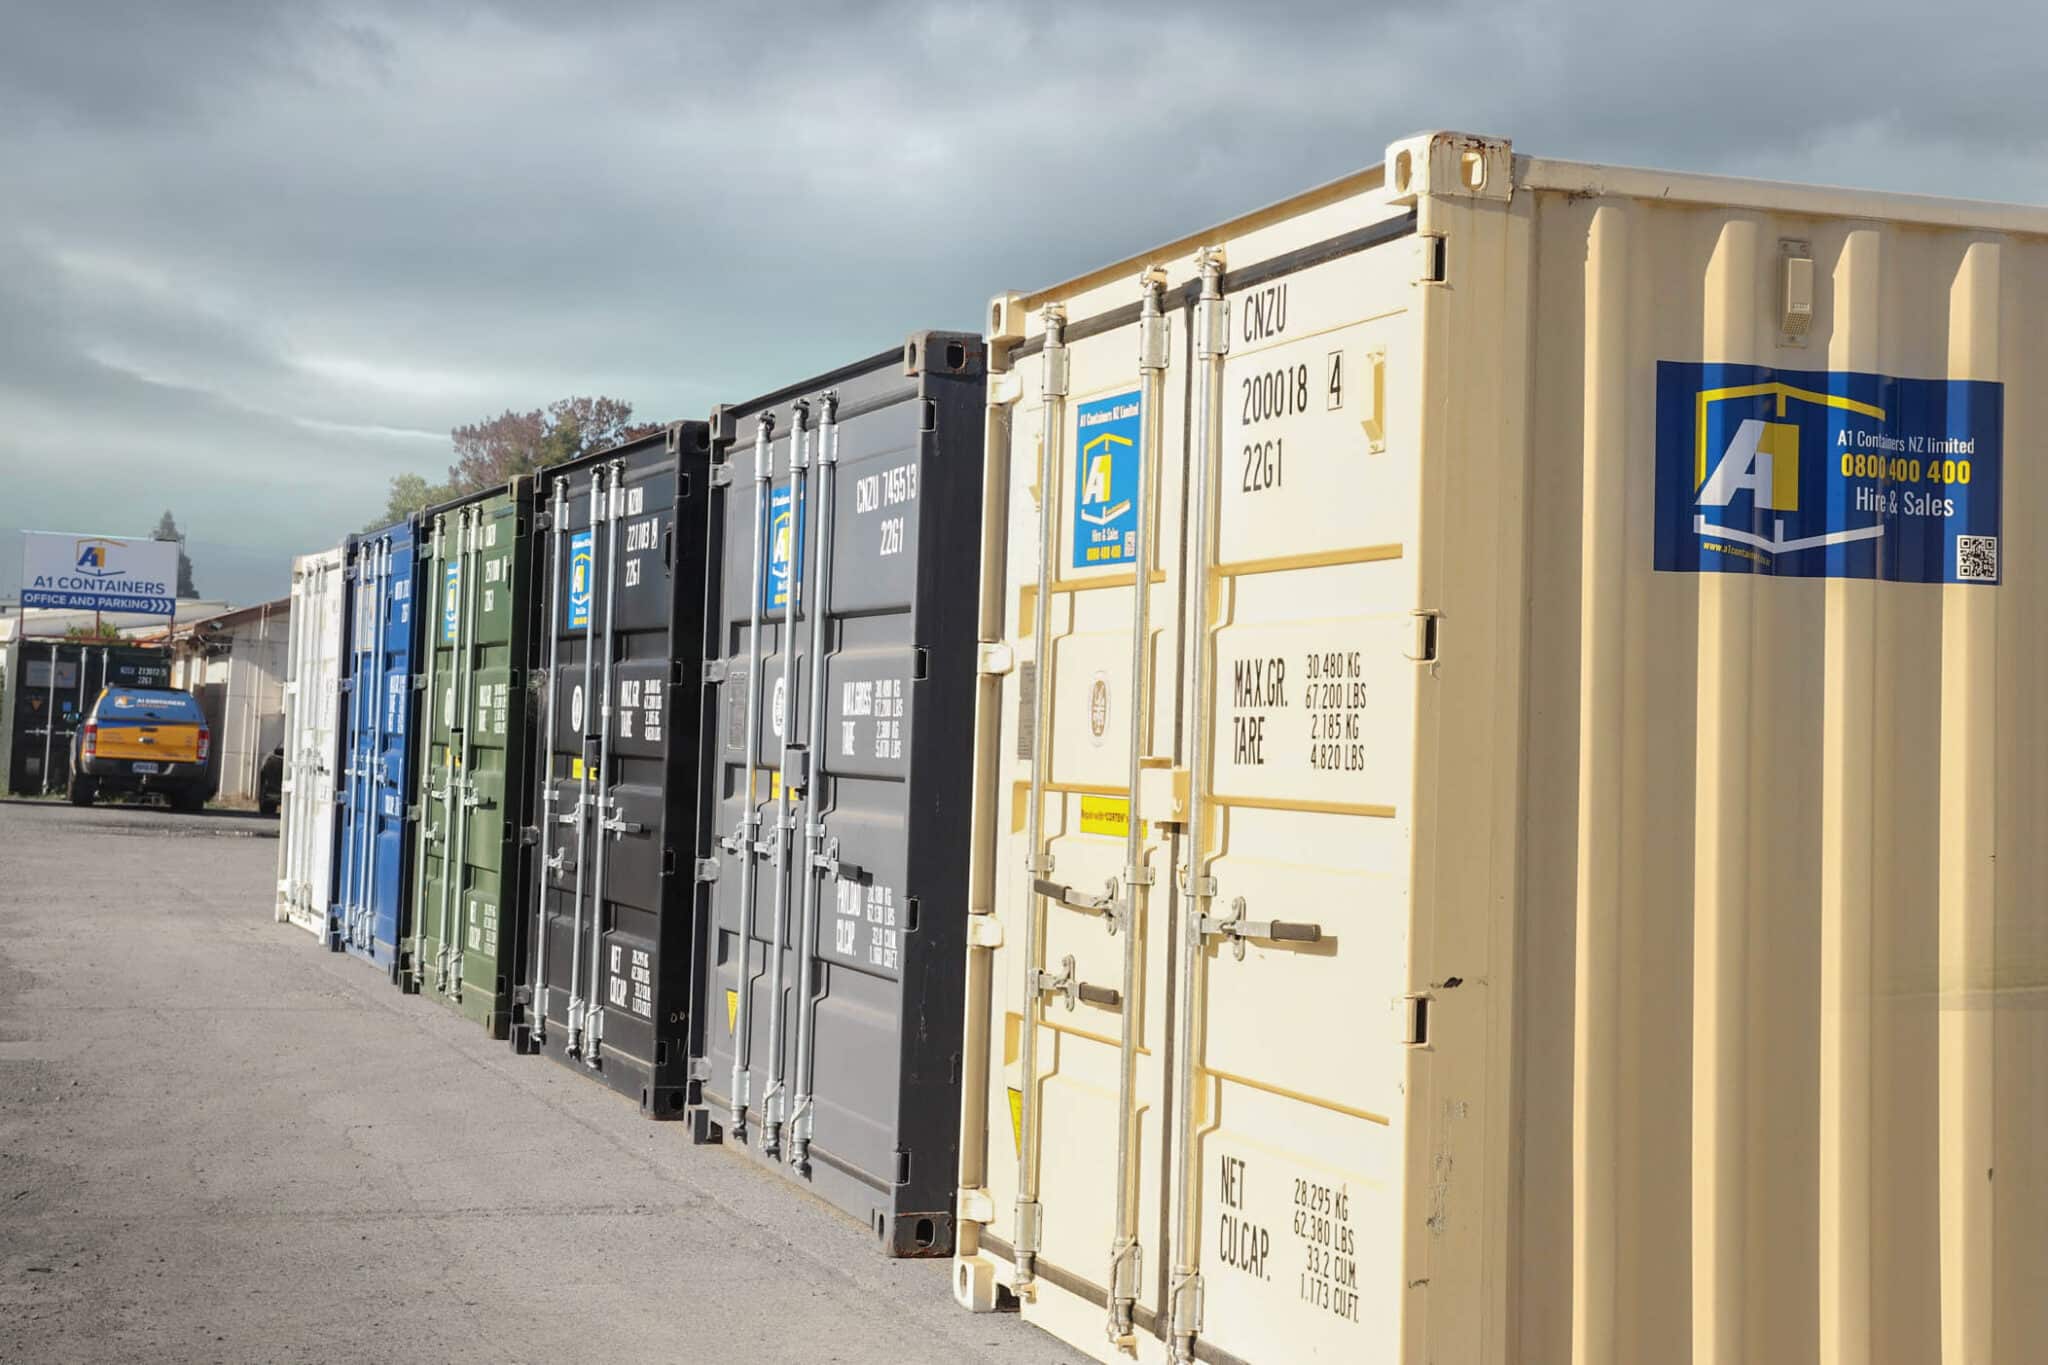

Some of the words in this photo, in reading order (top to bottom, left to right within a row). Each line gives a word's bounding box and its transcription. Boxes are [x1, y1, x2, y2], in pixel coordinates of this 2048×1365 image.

[1244, 283, 1287, 342] CNZU
[1242, 363, 1308, 426] 200018
[1330, 354, 1341, 406] 4
[1837, 429, 1853, 446] A1
[1857, 430, 1905, 452] Containers
[1908, 436, 1924, 453] NZ
[1927, 437, 1975, 454] limited
[1242, 437, 1282, 493] 22G1
[1841, 452, 1886, 479] 0800
[1889, 457, 1920, 483] 400
[1926, 459, 1971, 485] 400
[857, 475, 879, 514] CNZU
[882, 463, 917, 507] 745513
[1855, 486, 1886, 512] Hire
[1889, 490, 1898, 514] &
[1903, 491, 1954, 517] Sales
[880, 516, 904, 556] 22G1
[24, 593, 67, 605] OFFICE
[68, 595, 96, 607] AND
[98, 597, 149, 610] PARKING
[33, 575, 53, 588] A1
[58, 577, 166, 595] CONTAINERS
[1233, 657, 1288, 708] MAX.GR.
[1306, 652, 1343, 679] 30.480
[1347, 651, 1361, 679] KG
[1305, 683, 1343, 709] 67.200
[1346, 682, 1366, 709] LBS
[1233, 716, 1265, 765] TARE
[1311, 713, 1341, 740] 2.185
[1345, 713, 1359, 740] KG
[1310, 743, 1341, 770] 4.820
[1344, 743, 1364, 771] LBS
[1220, 1154, 1246, 1211] NET
[1294, 1177, 1331, 1216] 28.295
[1335, 1191, 1349, 1222] KG
[1220, 1213, 1271, 1282] CU.CAP.
[1306, 1244, 1330, 1279] 33.2
[1294, 1209, 1330, 1247] 62.380
[1334, 1223, 1354, 1257] LBS
[1301, 1272, 1329, 1310] 1.173
